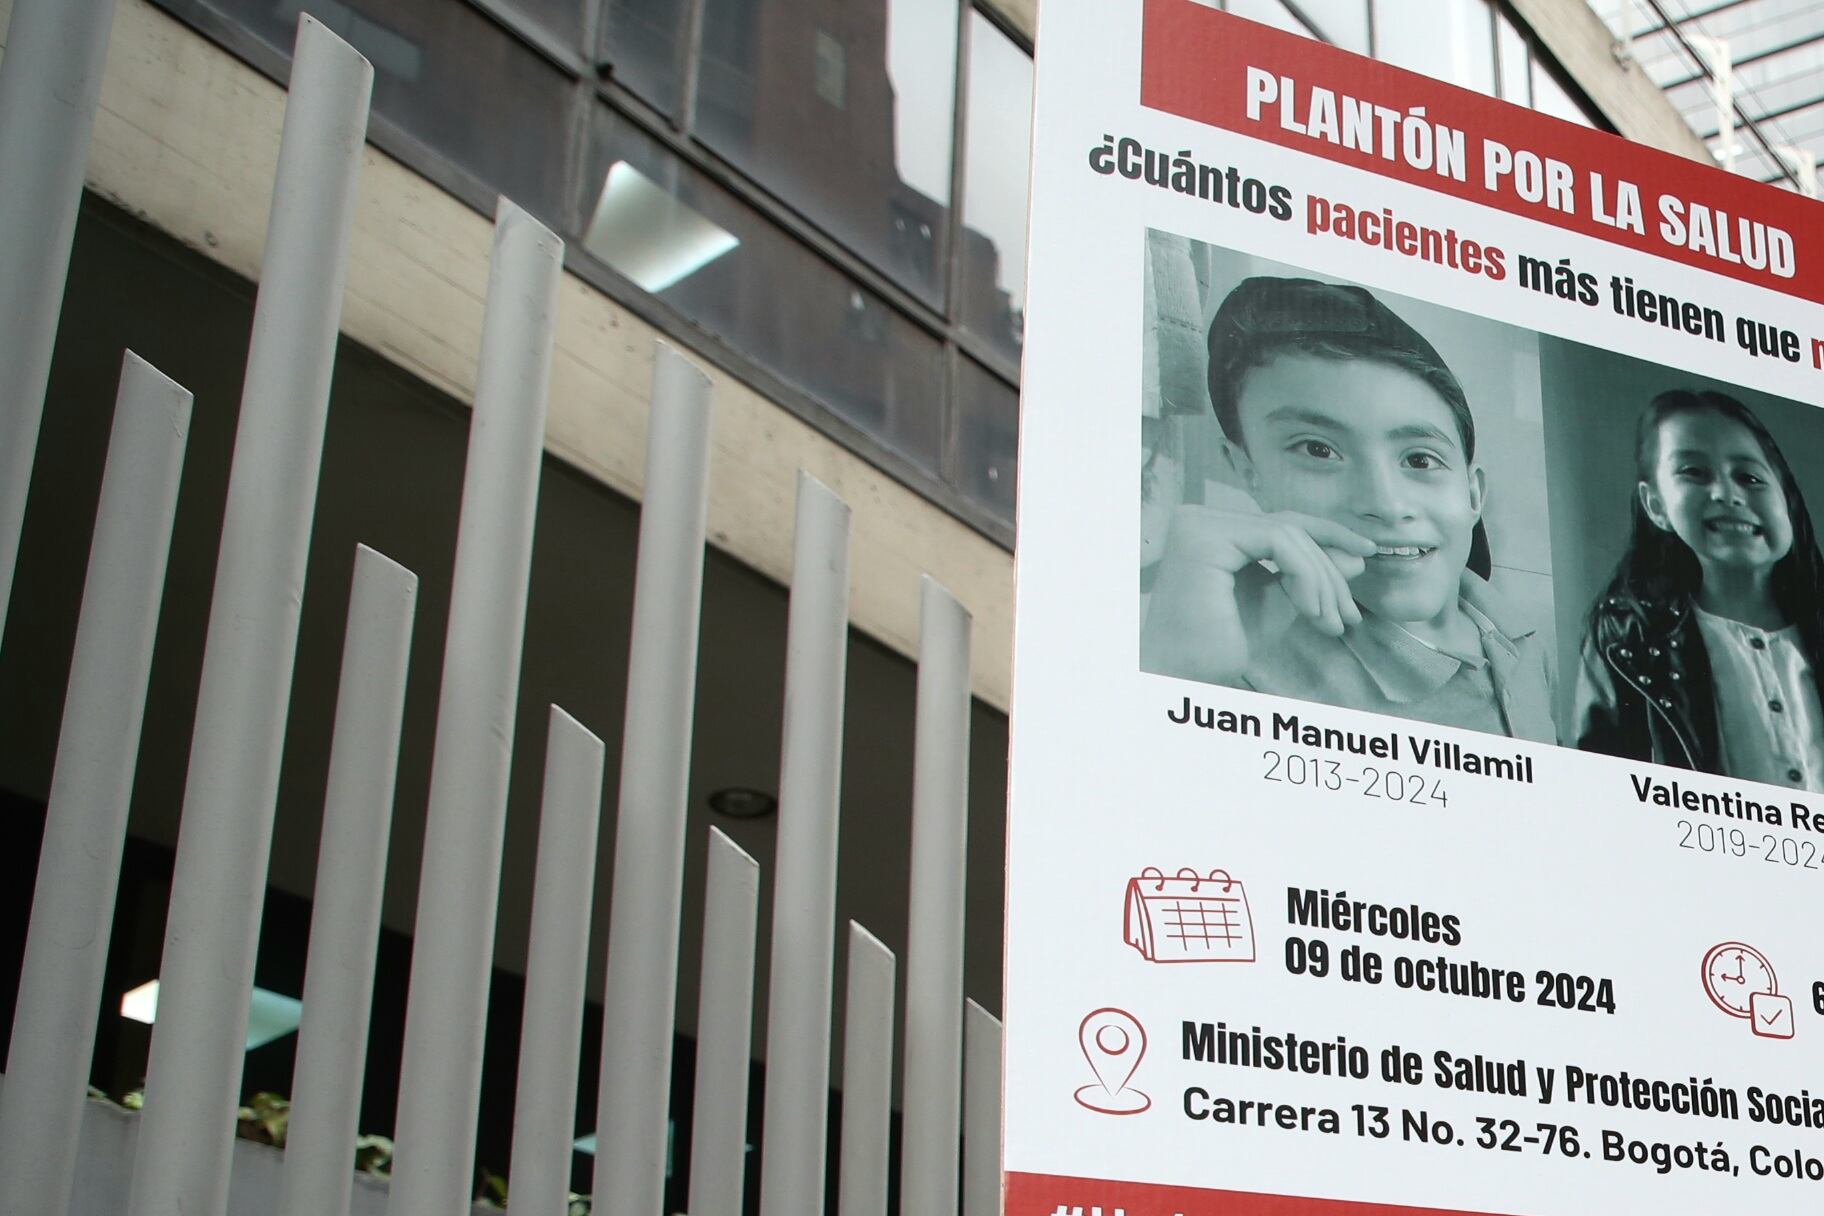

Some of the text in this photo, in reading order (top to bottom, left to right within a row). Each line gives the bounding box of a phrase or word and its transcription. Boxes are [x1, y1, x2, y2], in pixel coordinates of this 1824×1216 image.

[1246, 65, 1796, 279] PLANTÓN POR LA SALUD
[1088, 134, 1293, 222] ¿Cuántos
[1306, 194, 1506, 281] pacientes
[1518, 254, 1600, 307] más
[1609, 275, 1726, 344] tienen
[1735, 316, 1801, 363] que
[1167, 696, 1533, 784] Juan Manuel Villamil
[1263, 750, 1448, 809] 2013-2024
[1630, 773, 1783, 827] Valentina
[1287, 886, 1462, 947] Miércoles
[1285, 936, 1617, 1015] 09 de octubre 2024
[1182, 1020, 1370, 1080] Ministerio
[1380, 1044, 1423, 1086] de
[1433, 1050, 1527, 1097] Salud
[1535, 1066, 1555, 1105] y
[1565, 1064, 1739, 1121] Protección
[1183, 1086, 1340, 1135] Carrera
[1351, 1104, 1390, 1139] 13
[1401, 1108, 1465, 1147] No.
[1475, 1116, 1591, 1159] 32-76.
[1601, 1129, 1740, 1178] Bogotá,
